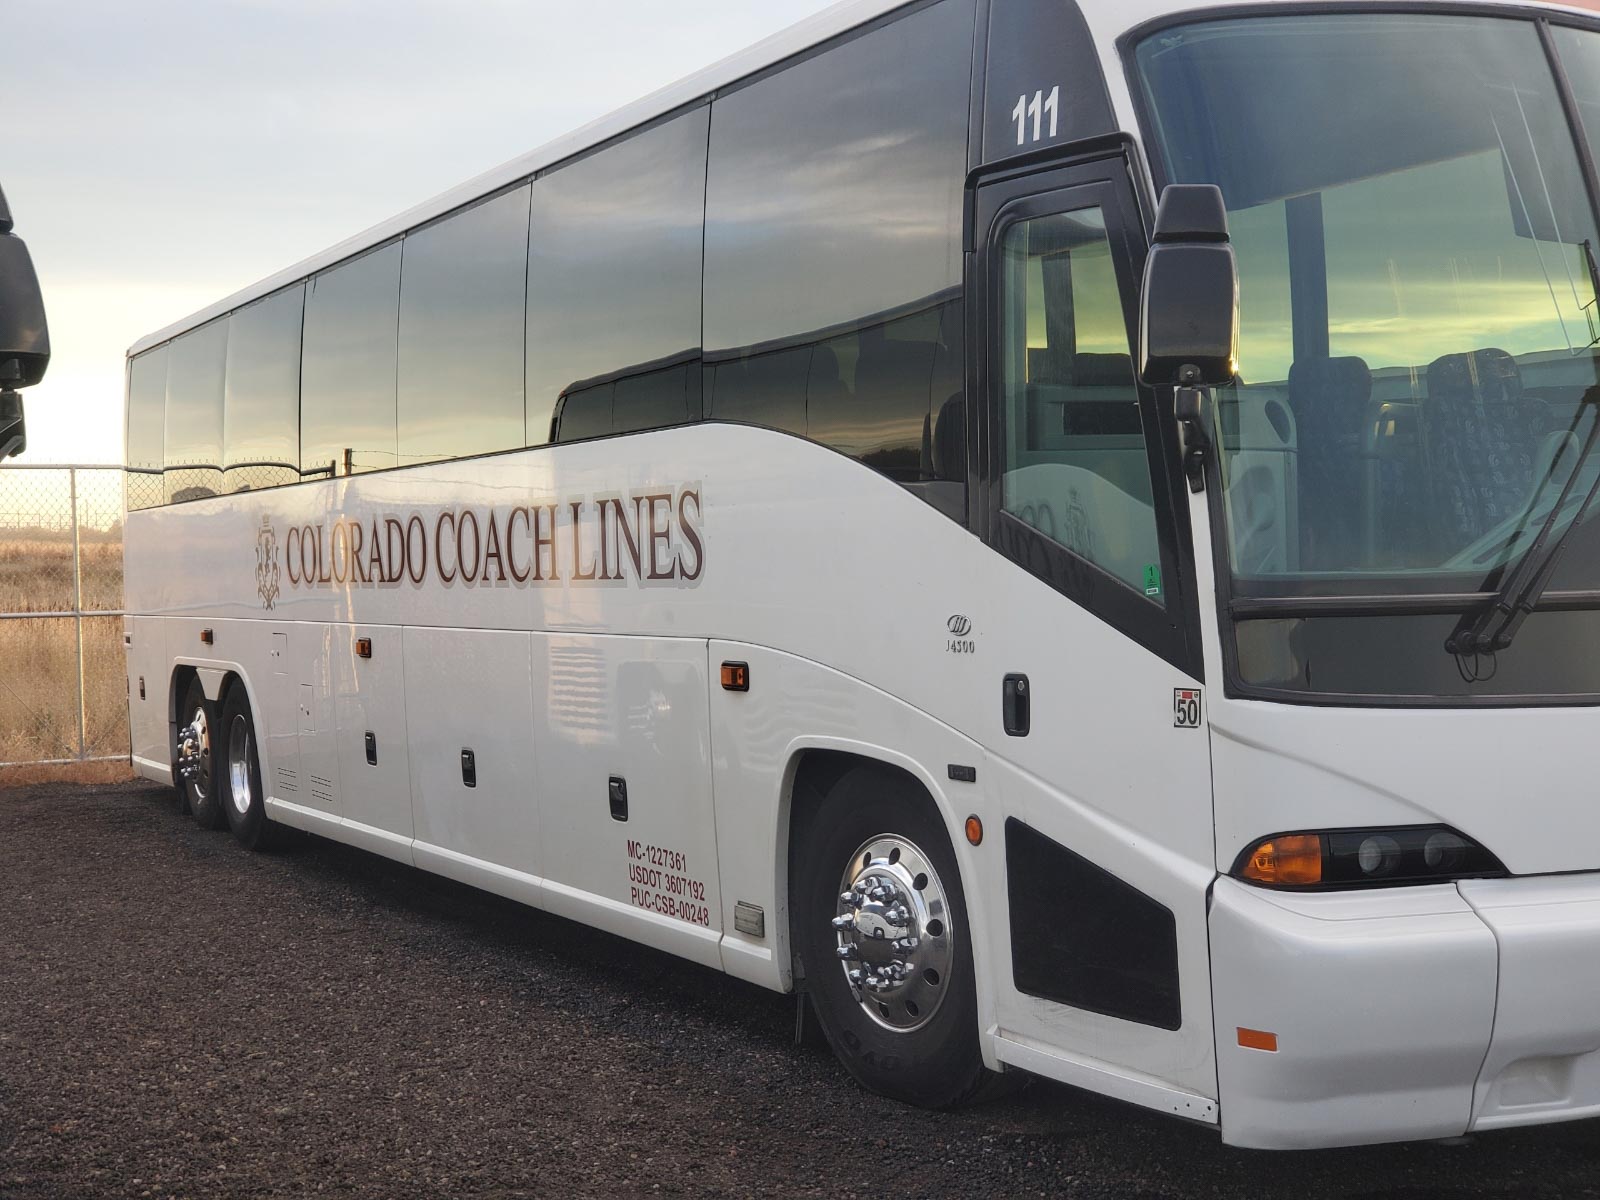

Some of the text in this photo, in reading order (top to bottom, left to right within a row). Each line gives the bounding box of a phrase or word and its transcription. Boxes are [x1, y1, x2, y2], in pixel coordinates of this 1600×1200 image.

[1012, 85, 1059, 146] 111
[286, 489, 704, 585] COLORADO COACH LINES
[1176, 698, 1198, 725] 50
[627, 839, 687, 873] MC-1227361
[628, 863, 706, 902] USDOT 3607192
[631, 886, 710, 927] PUC-CSB-00248
